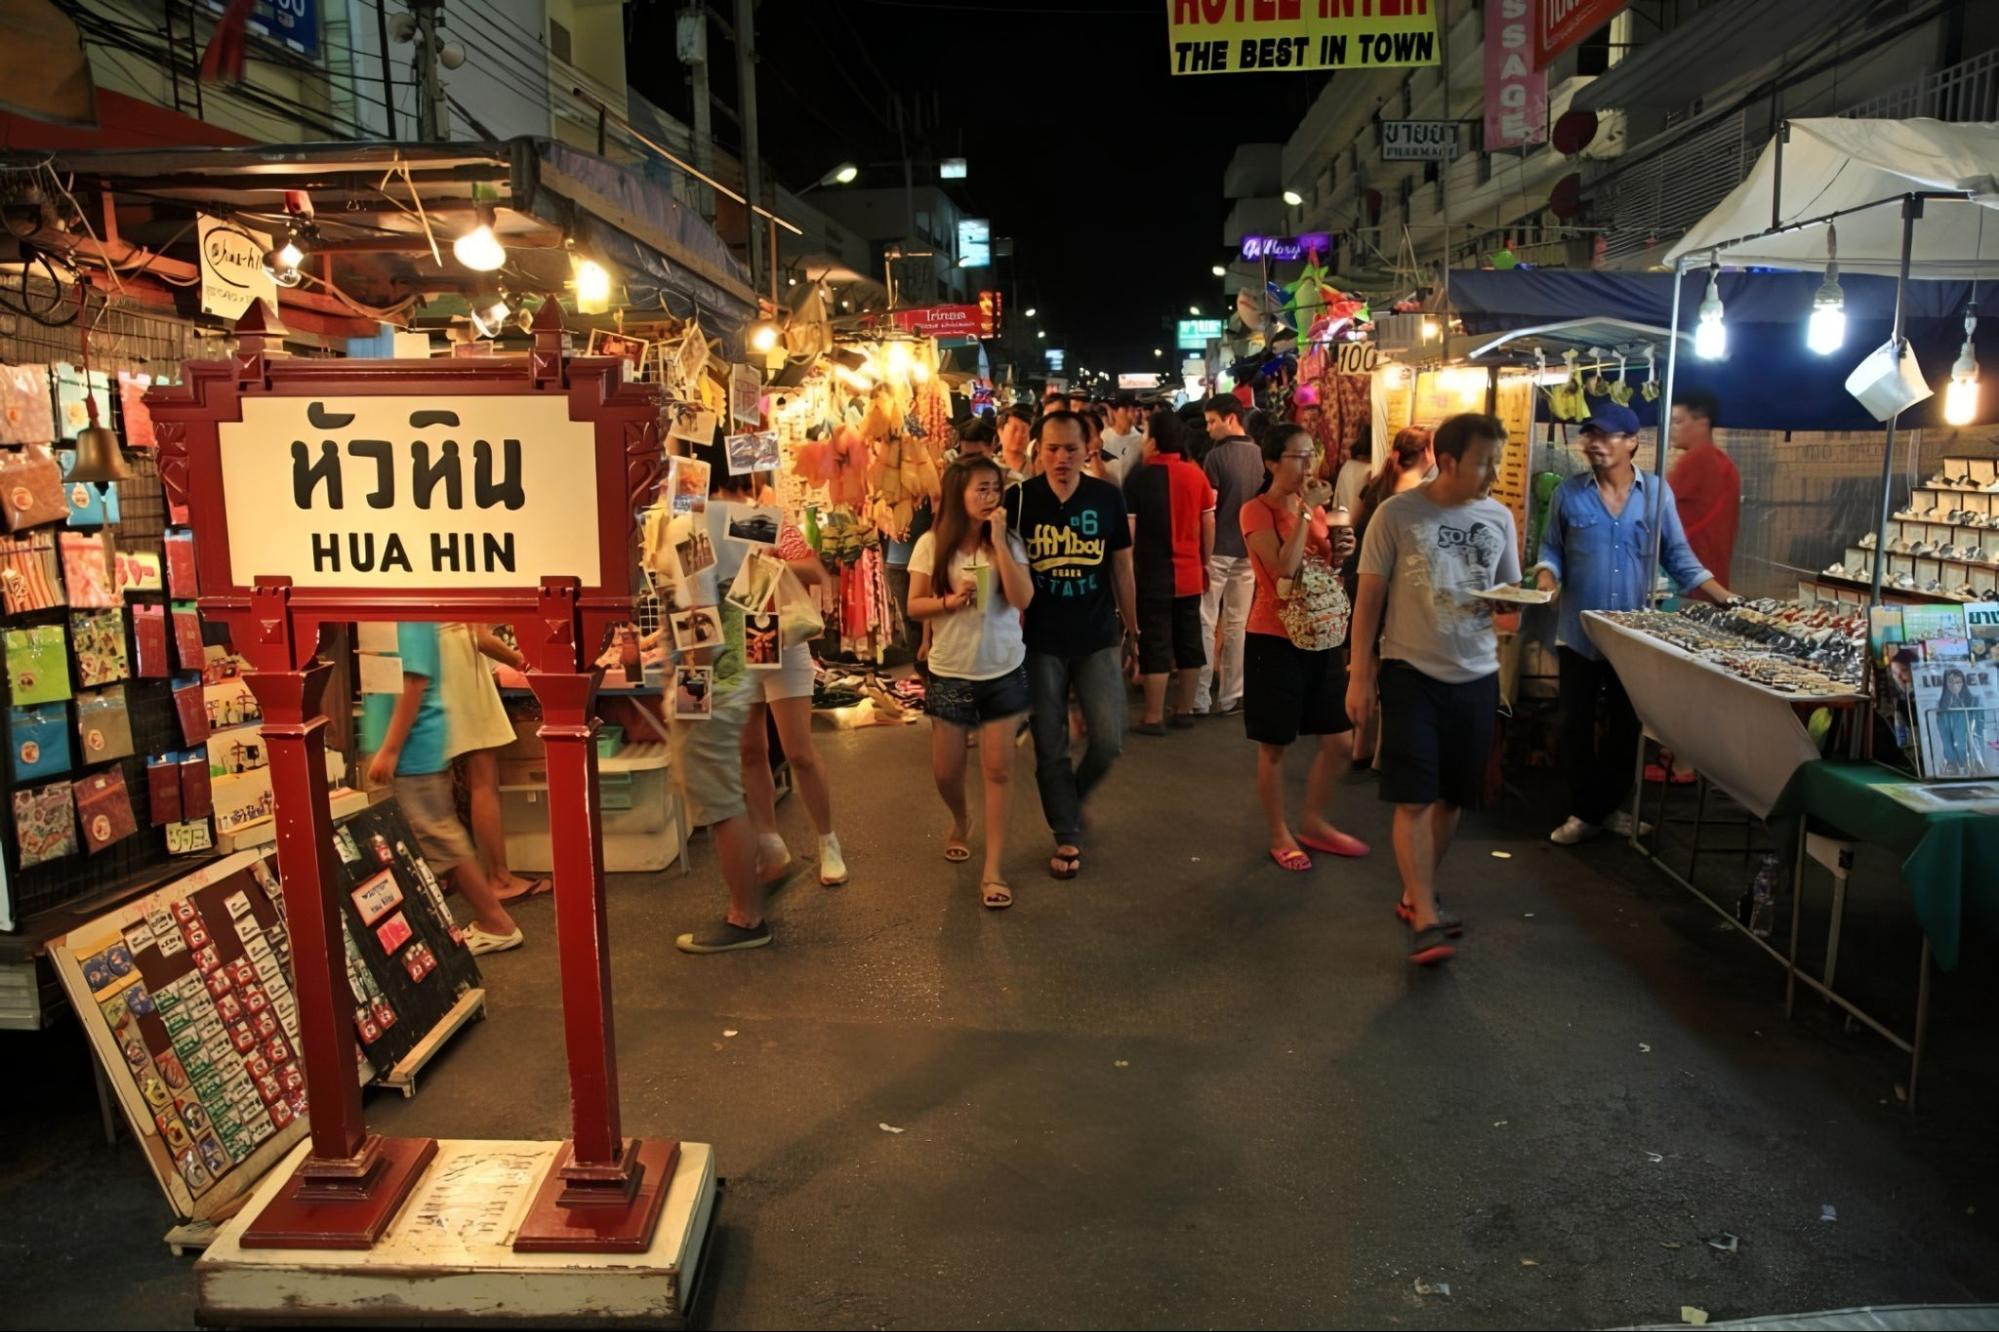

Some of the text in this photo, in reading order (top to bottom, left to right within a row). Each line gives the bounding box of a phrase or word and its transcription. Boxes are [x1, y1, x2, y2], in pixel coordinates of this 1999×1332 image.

[1175, 31, 1434, 73] THE BEST IN TOWN
[1340, 344, 1378, 372] 100
[291, 401, 526, 512] หัวหิน
[311, 532, 517, 573] HUA HIN
